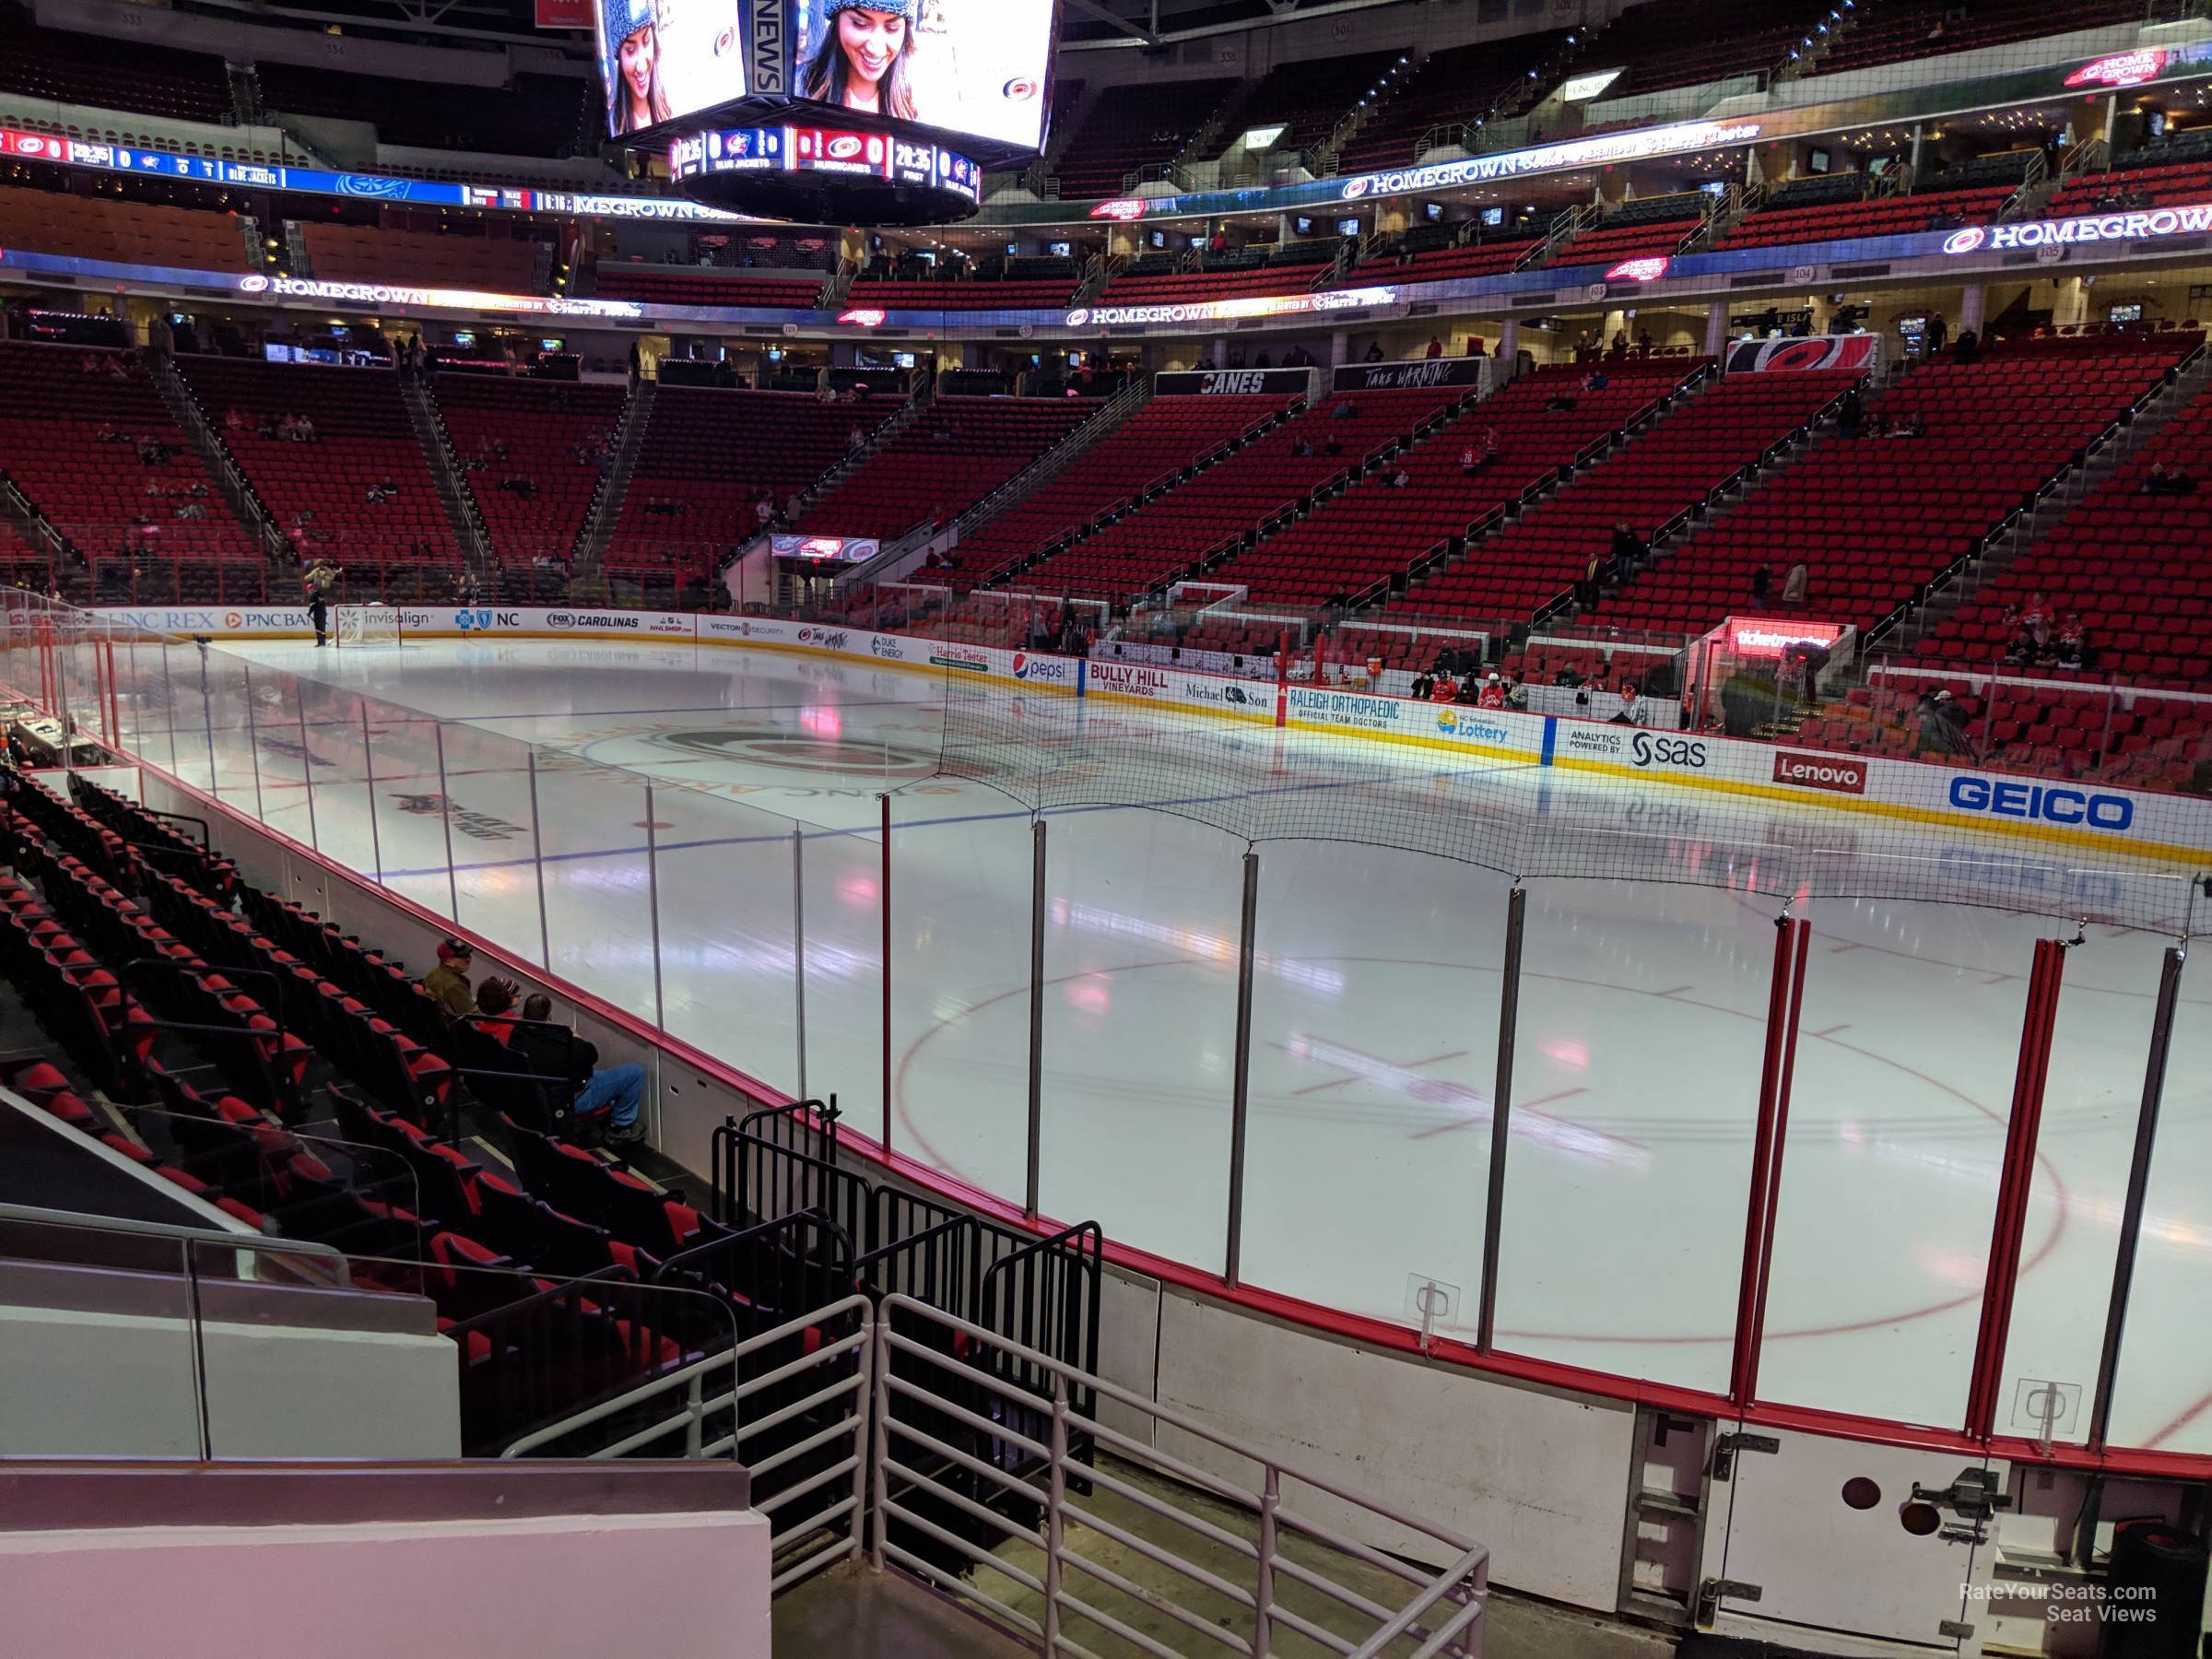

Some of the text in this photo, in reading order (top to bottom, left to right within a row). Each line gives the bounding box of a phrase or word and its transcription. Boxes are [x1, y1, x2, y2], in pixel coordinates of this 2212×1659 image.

[757, 0, 780, 89] NEWS
[2101, 63, 2157, 78] GROWN
[2102, 53, 2154, 70] HOME
[50, 140, 62, 158] 0
[768, 135, 778, 153] 0
[866, 137, 884, 164] 0
[119, 150, 131, 168] 0
[735, 159, 771, 169] JACKETS
[939, 151, 951, 177] 0
[178, 164, 188, 174] 0
[248, 171, 276, 185] JACKETS
[1371, 158, 1520, 194] HOMEGROWN
[546, 194, 565, 211] 6:16
[2041, 247, 2059, 258] 105
[1794, 268, 1811, 279] 104
[273, 278, 429, 304] HOMEGROWN
[1324, 291, 1359, 309] Harris
[561, 300, 601, 315] Harris
[1092, 305, 1216, 324] HOMEGROWN
[1201, 372, 1265, 394] CANES
[1365, 361, 1453, 388] TAKE WARNING
[167, 612, 215, 629] REX
[364, 610, 429, 628] invisalign
[497, 612, 520, 627] NC
[552, 615, 640, 629] FOX CAROLINAS
[711, 622, 784, 636] VECTOR SECURITY
[881, 637, 897, 648] DUKE
[881, 648, 905, 660] ENERGY
[936, 645, 988, 663] Harris Teeter
[1030, 661, 1066, 680] pepsi
[1090, 665, 1169, 688] BULLY HILL
[1102, 681, 1155, 697] VINEYARDS
[1185, 683, 1223, 702] Michael
[1248, 692, 1268, 708] Son
[1289, 689, 1400, 720] RALEIGH ORTHOPAEDIC
[1299, 710, 1388, 730] OFFICIAL TEAM DOCTORS
[1458, 723, 1508, 744] Lottery
[1571, 731, 1621, 746] ANALYTICS
[1570, 740, 1621, 754] POWERED BY
[1781, 759, 1859, 786] Lenovo
[1948, 775, 2135, 831] GEICO
